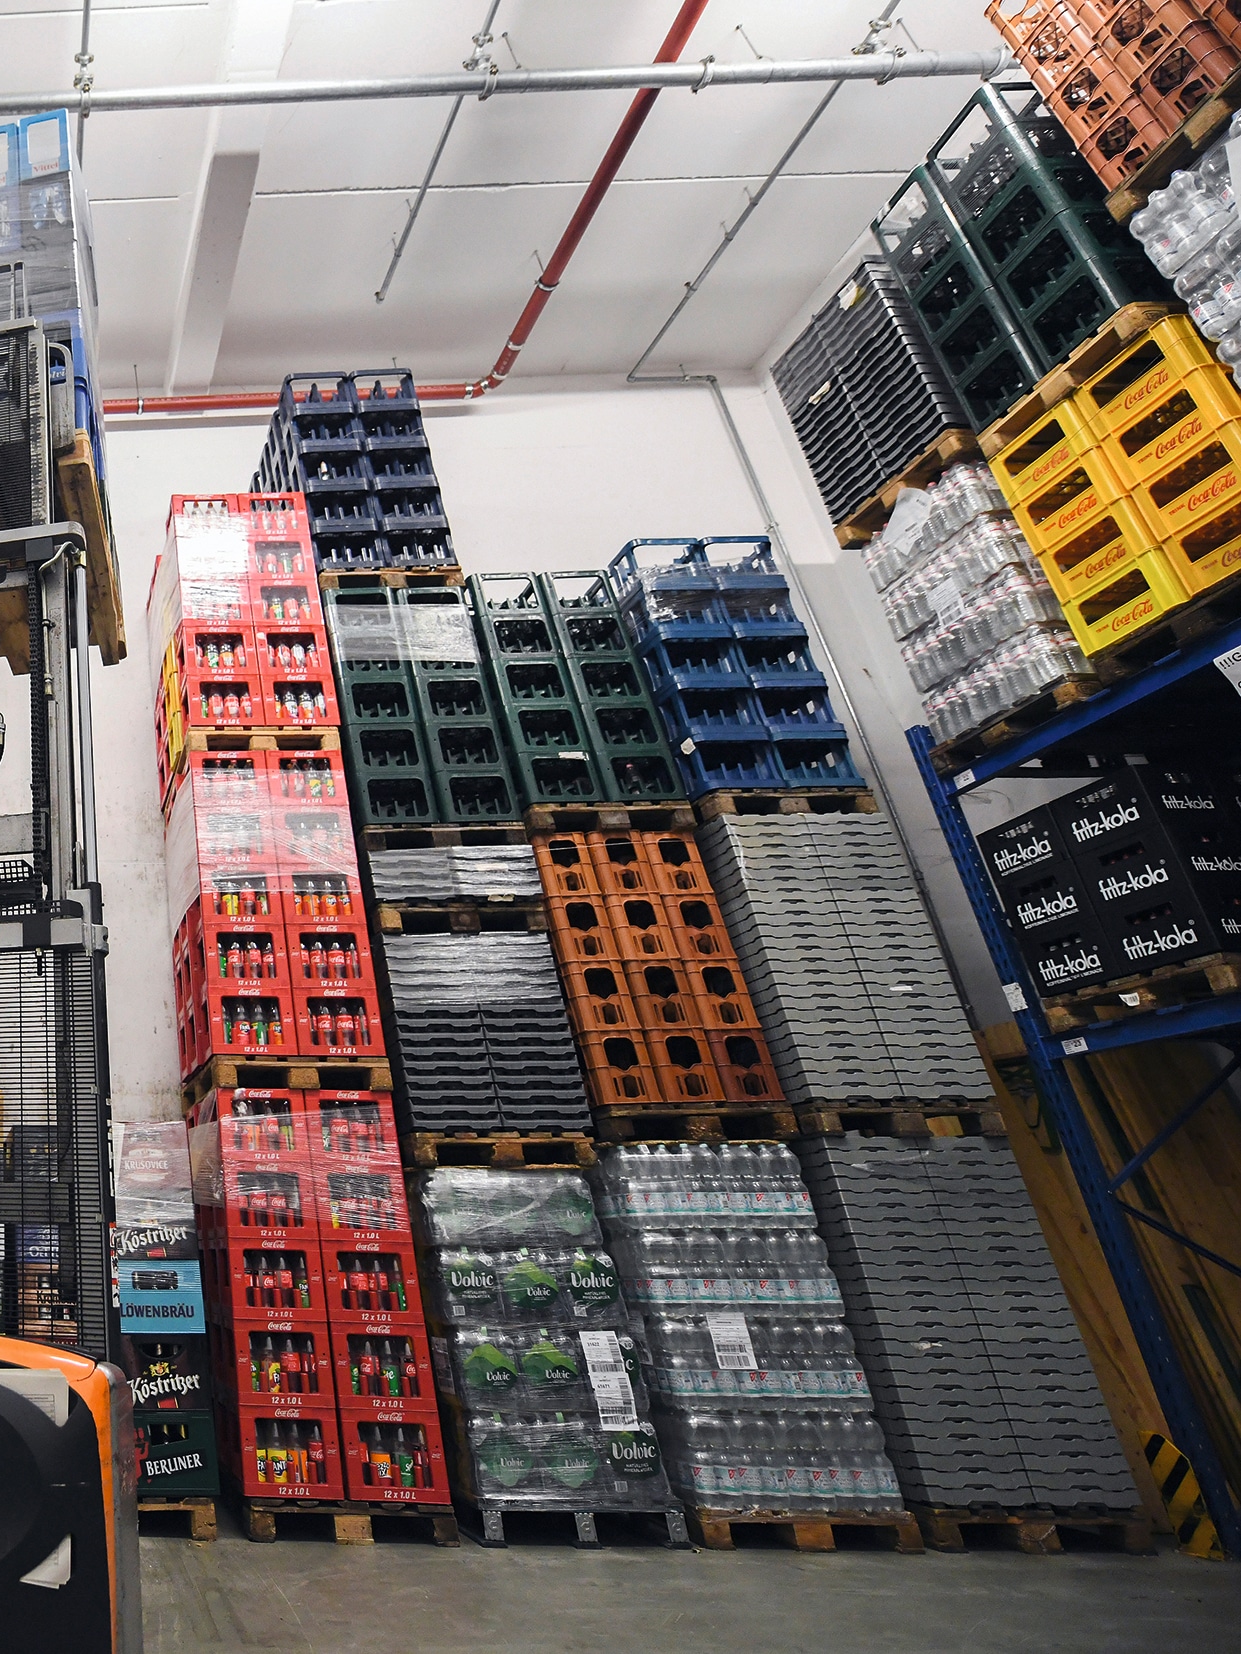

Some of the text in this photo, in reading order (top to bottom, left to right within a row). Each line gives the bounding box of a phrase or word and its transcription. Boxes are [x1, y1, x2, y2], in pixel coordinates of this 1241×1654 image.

[33, 162, 58, 172] Vittel
[1125, 368, 1168, 410] Coca-Cola
[1156, 417, 1202, 459] Coca-Cola
[1032, 446, 1070, 482] Coca-Cola
[1188, 471, 1236, 512] Coca-Cola
[1058, 494, 1097, 528] Coca-Cola
[1086, 543, 1126, 579] Coca-Cola
[1111, 599, 1154, 632] Coca-Cola
[1162, 795, 1215, 809] fritz-kola
[1071, 804, 1140, 842] fritz-kola
[993, 837, 1052, 872] fritz-kola
[1098, 865, 1168, 900] fritz-kola
[1017, 891, 1077, 924] fritz-kola
[1122, 924, 1198, 959] fritz-kola
[1038, 949, 1101, 981] fritz-kola
[337, 1091, 359, 1099] Coca-Cola
[115, 1225, 187, 1256] Köstritzer
[262, 1240, 285, 1248] Coca-Cola
[356, 1243, 379, 1251] Coca-Cola
[451, 1271, 494, 1288] Volvic
[570, 1272, 614, 1288] Volvic
[526, 1287, 551, 1297] Volvic
[120, 1303, 194, 1318] LÖWENBRÄU
[268, 1322, 292, 1331] Coca-Cola
[366, 1325, 390, 1334] Coca-Cola
[486, 1372, 510, 1381] Volvic
[545, 1370, 570, 1379] Volvic
[127, 1374, 200, 1406] Köstritzer
[275, 1409, 300, 1417] Coca-Cola
[378, 1412, 402, 1421] Coca-Cola
[612, 1442, 656, 1459] Volvic
[145, 1453, 202, 1476] BERLINER
[500, 1458, 524, 1468] Volvic
[565, 1459, 590, 1468] Volvic
[279, 1487, 286, 1495] 12
